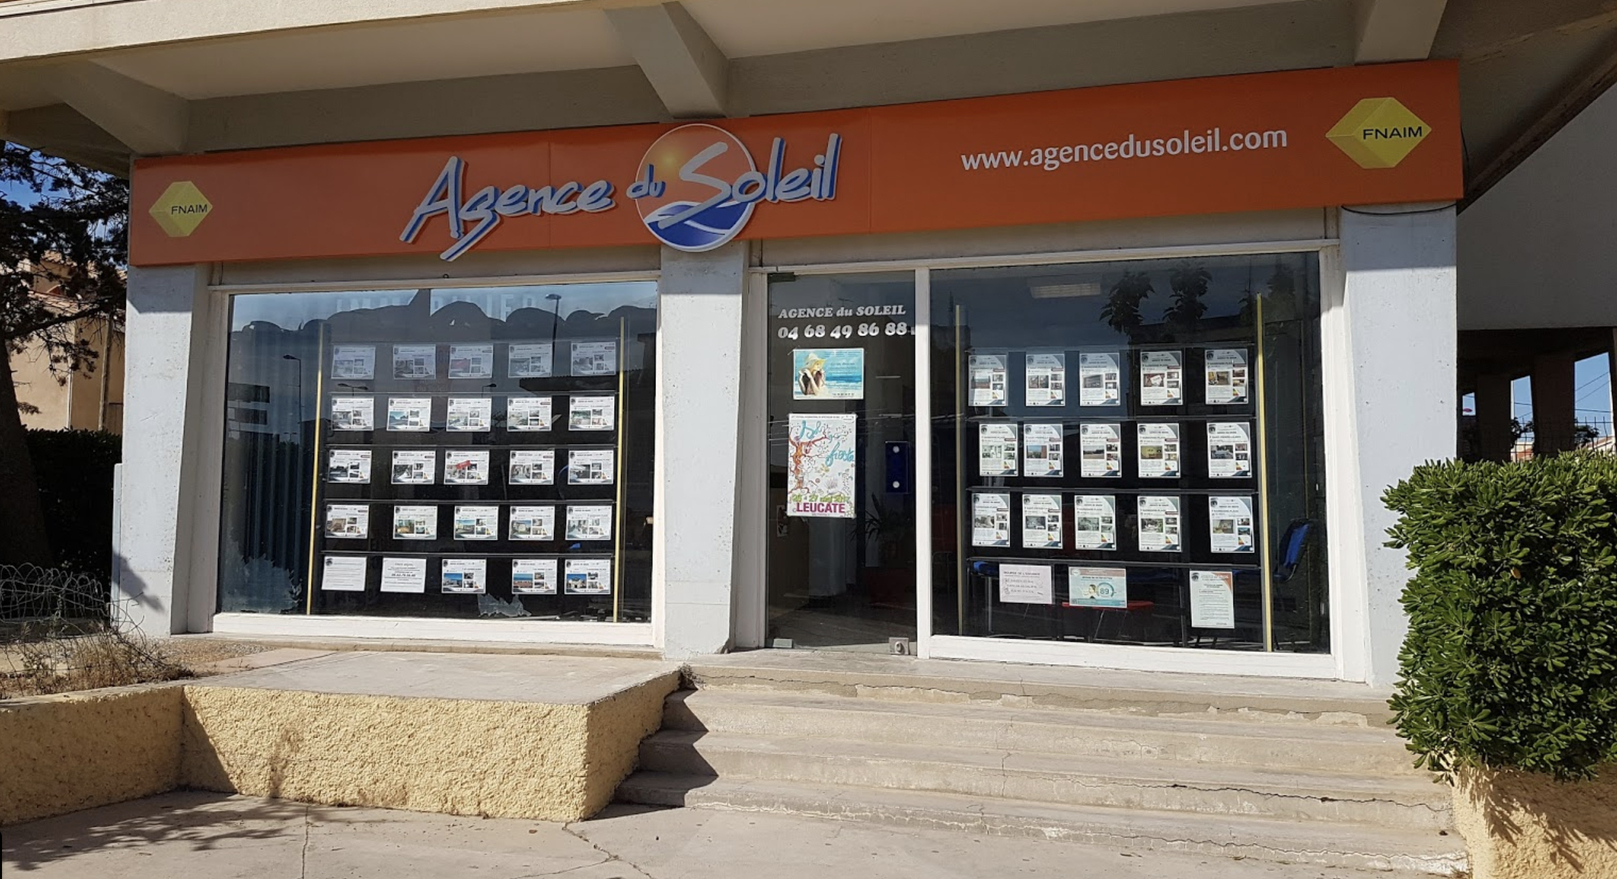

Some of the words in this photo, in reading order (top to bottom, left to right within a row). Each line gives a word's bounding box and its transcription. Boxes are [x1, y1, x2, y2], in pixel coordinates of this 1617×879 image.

[1362, 126, 1422, 140] FNAIM
[961, 128, 1287, 171] www.agencedusoleil.com
[400, 156, 615, 261] Agence
[626, 163, 667, 199] du
[657, 132, 842, 230] Soleil
[171, 204, 208, 215] FNAIM
[778, 307, 833, 319] AGENCE
[836, 307, 853, 317] du
[856, 305, 907, 316] SOLEIL
[777, 326, 799, 340] 04
[804, 324, 826, 338] 68
[830, 325, 853, 339] 49
[857, 323, 880, 336] 86
[885, 321, 908, 336] 88
[796, 502, 846, 514] LEUCATE
